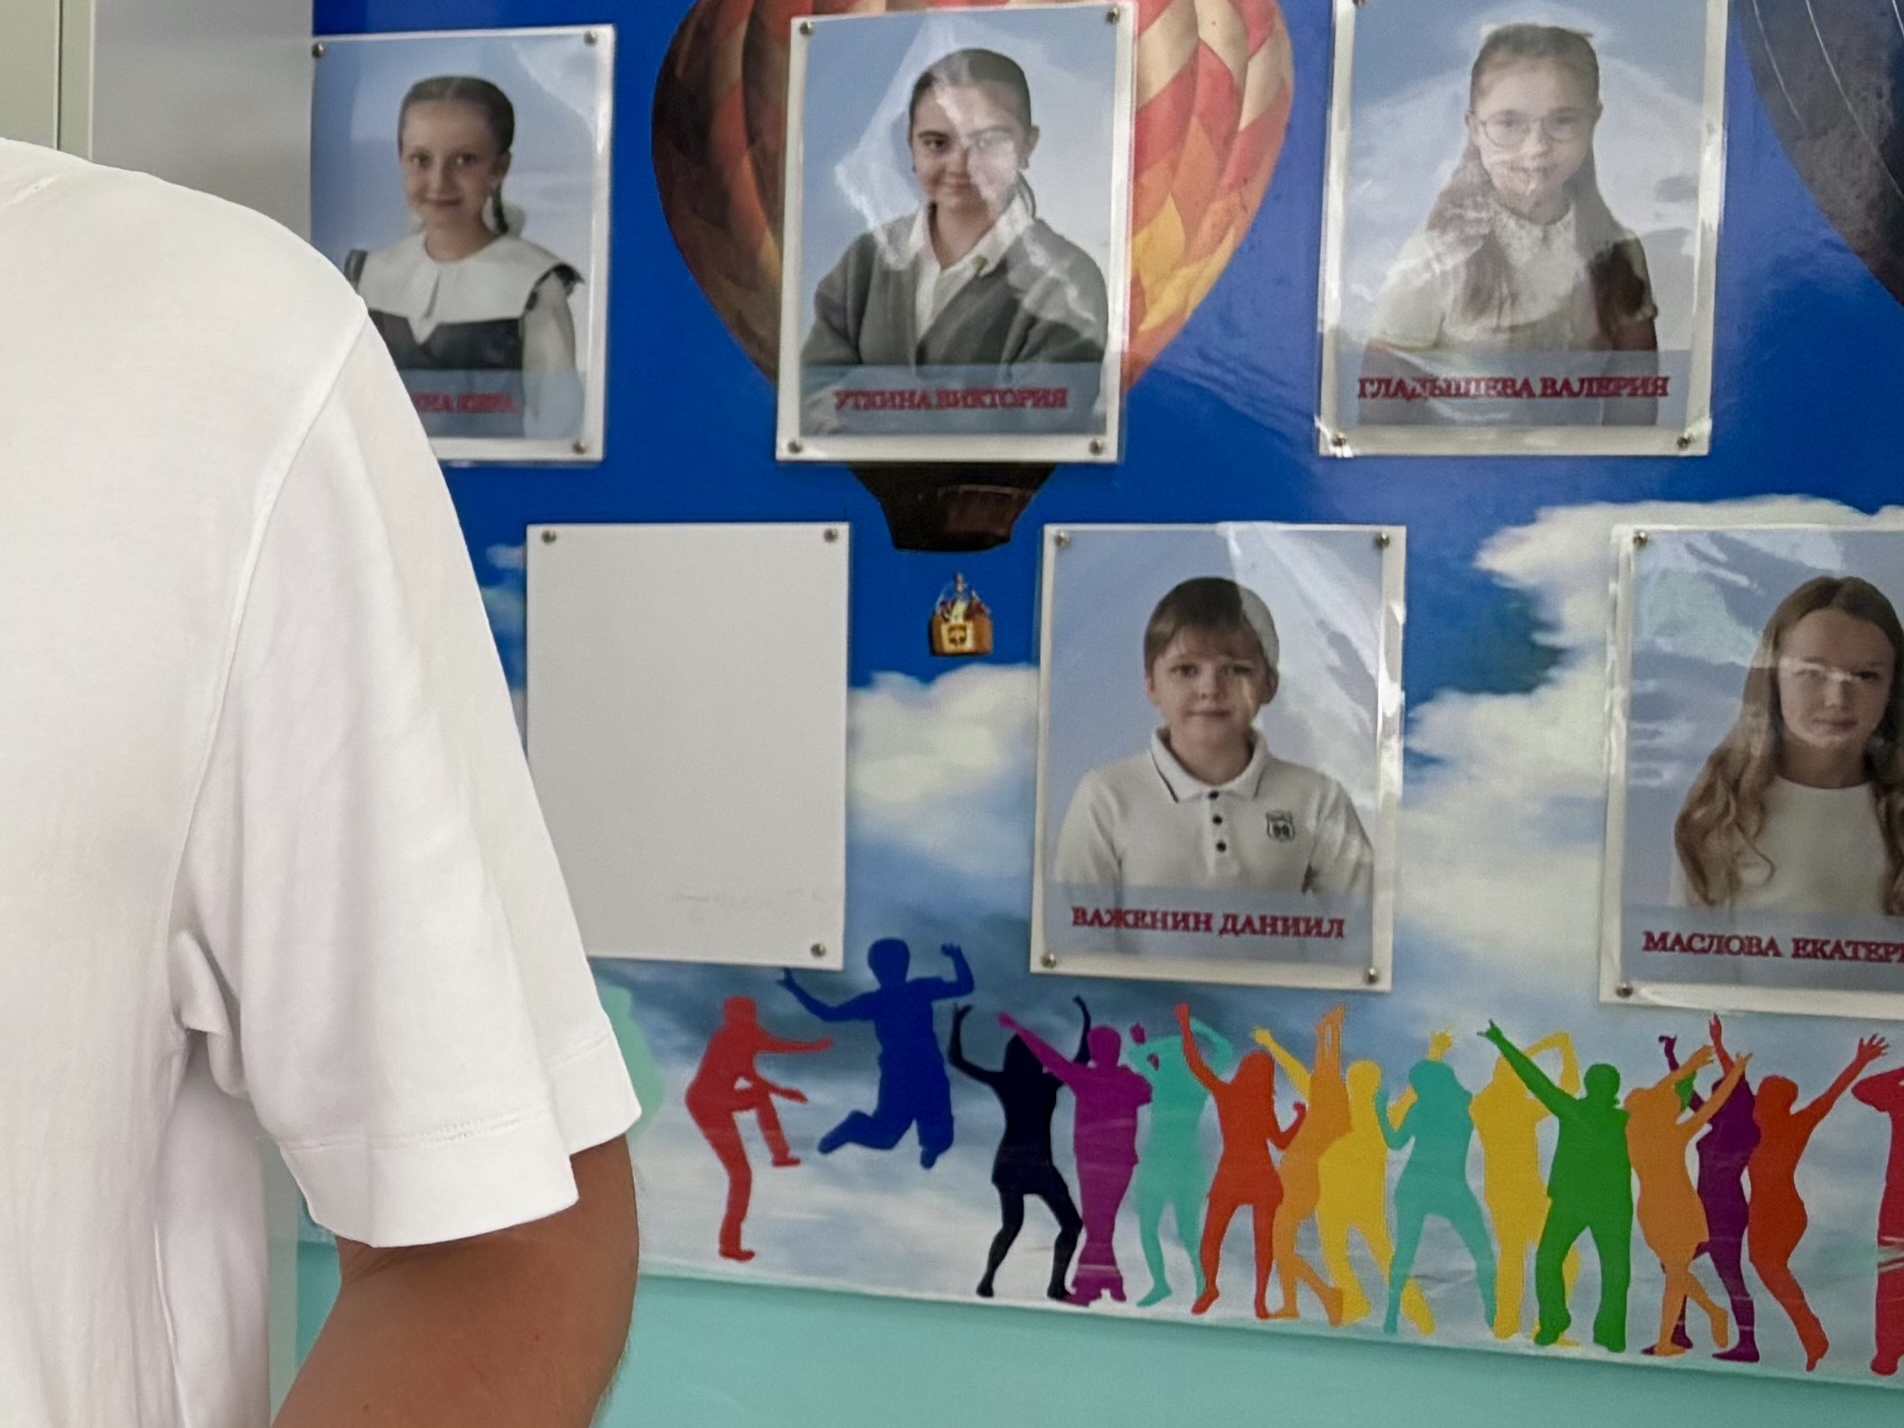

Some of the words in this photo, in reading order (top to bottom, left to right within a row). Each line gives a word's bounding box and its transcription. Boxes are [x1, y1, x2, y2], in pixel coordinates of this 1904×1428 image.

[935, 387, 1069, 409] ВИКТОРИЯ
[1358, 376, 1536, 401] ГЛАДЫШЕВА
[1539, 376, 1670, 398] ВАЛЕРИЯ
[1071, 906, 1213, 933] ВАЖЕНИН
[1218, 912, 1345, 940] ДАНИИЛ
[1643, 931, 1785, 957] МАСЛОВА
